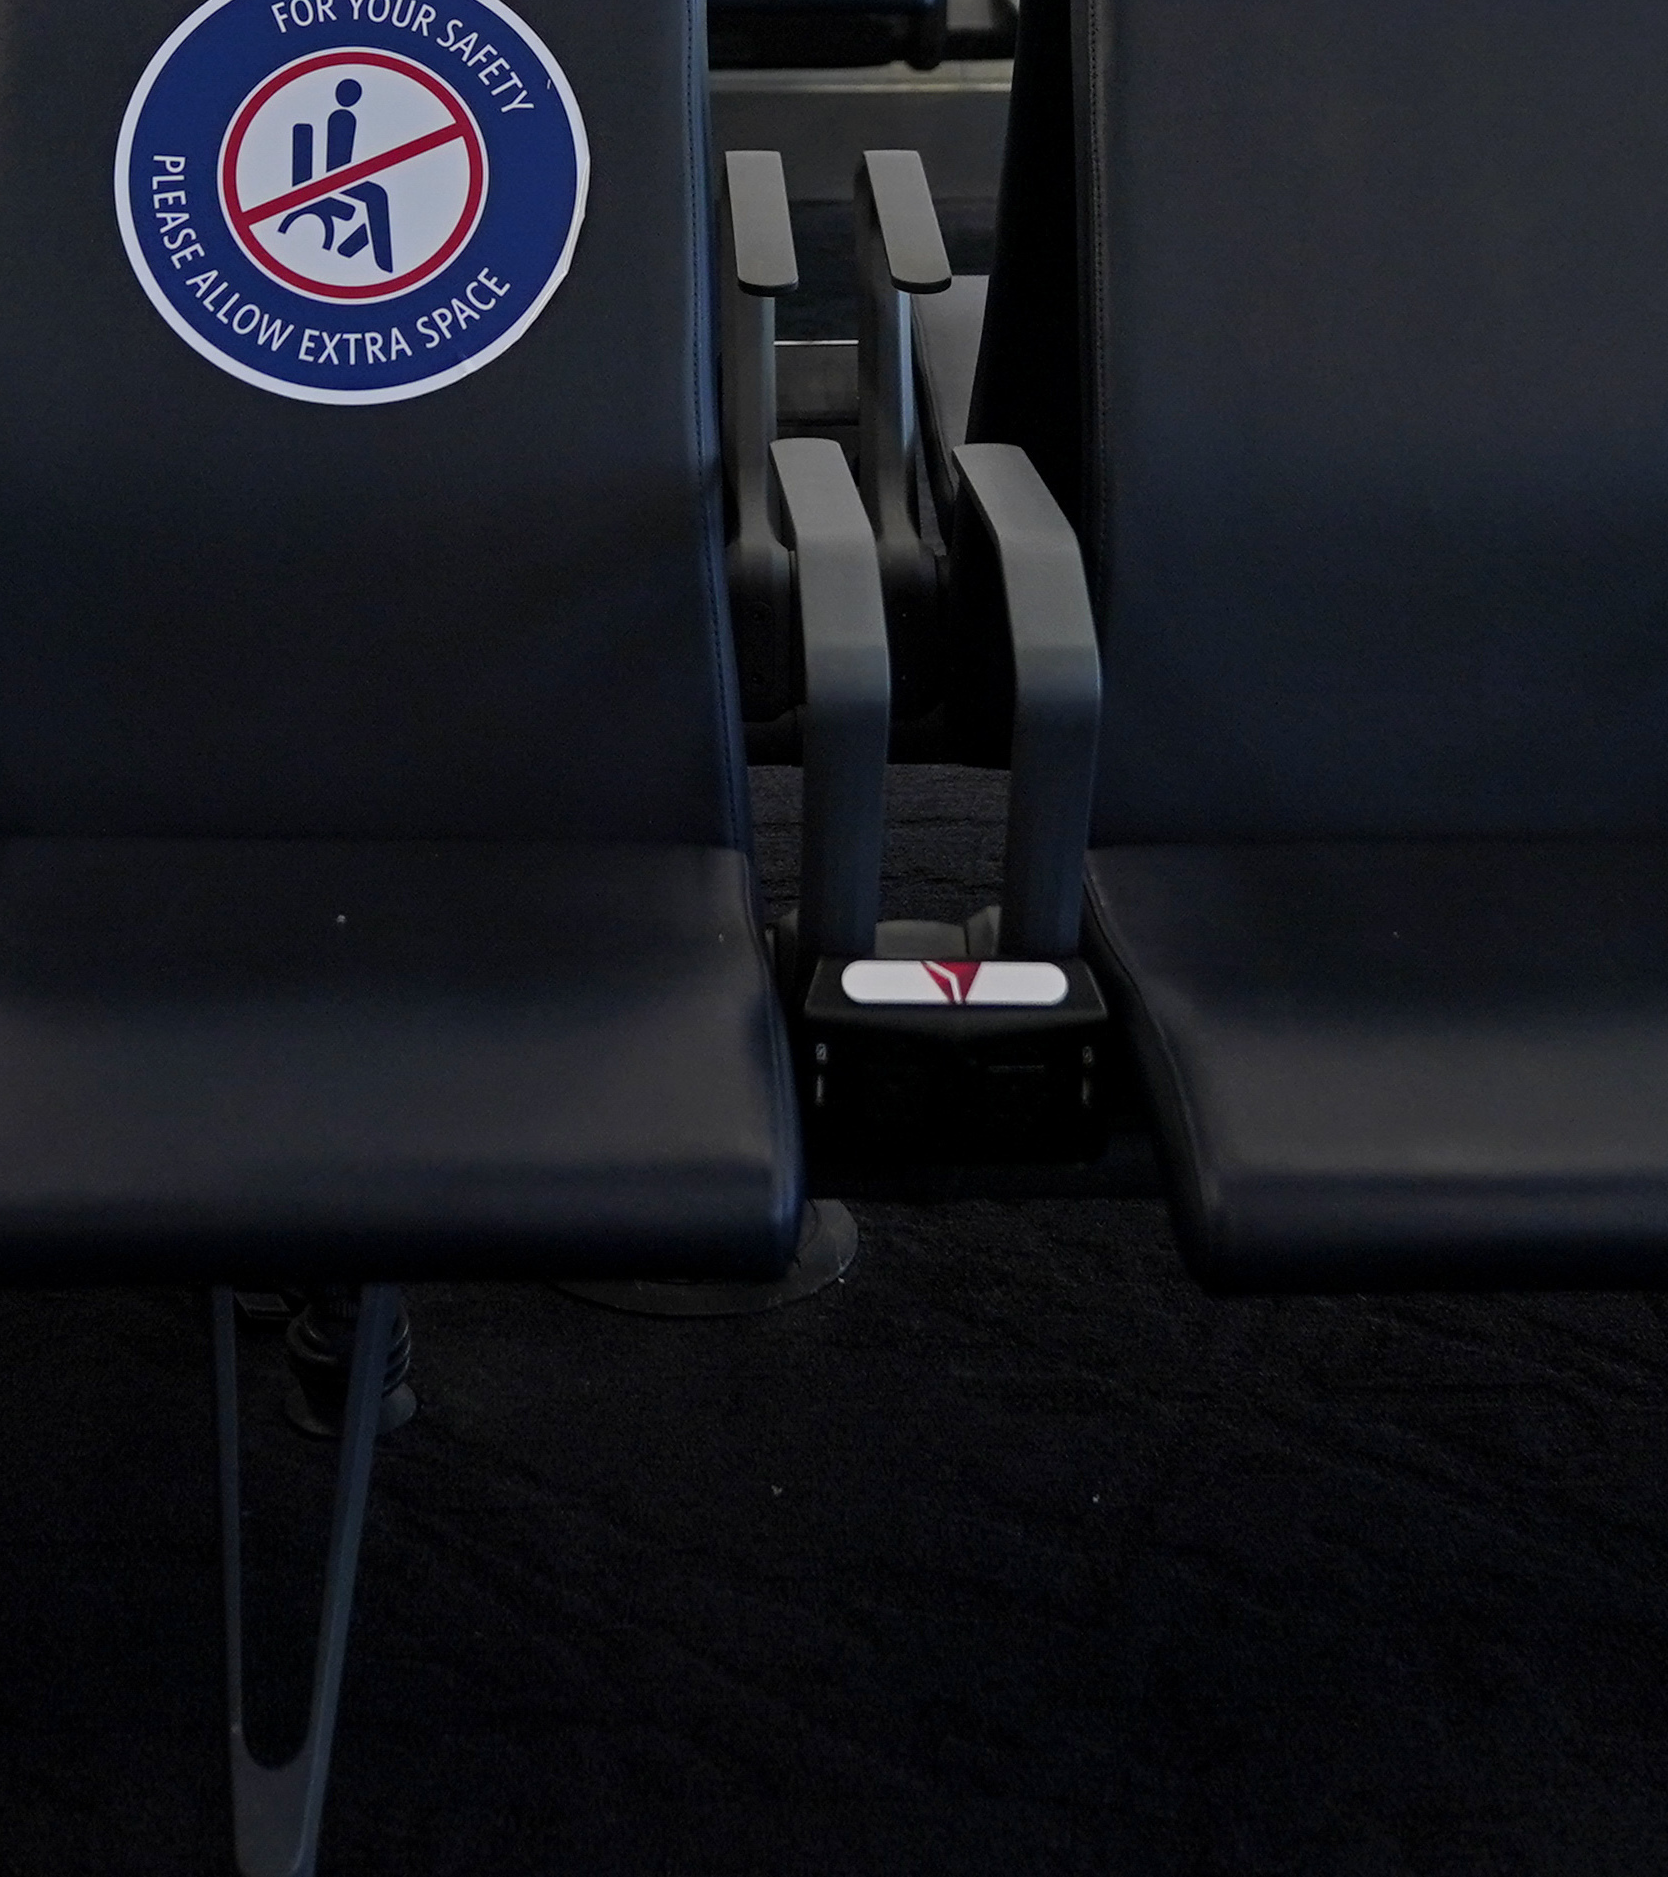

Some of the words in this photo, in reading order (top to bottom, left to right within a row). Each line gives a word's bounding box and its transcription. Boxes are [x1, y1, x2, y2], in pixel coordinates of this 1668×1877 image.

[436, 19, 534, 114] SAFETY
[152, 154, 205, 270] PLEASE
[186, 269, 295, 353] ALLOW
[298, 327, 413, 365] EXTRA
[415, 267, 511, 349] SPACE
